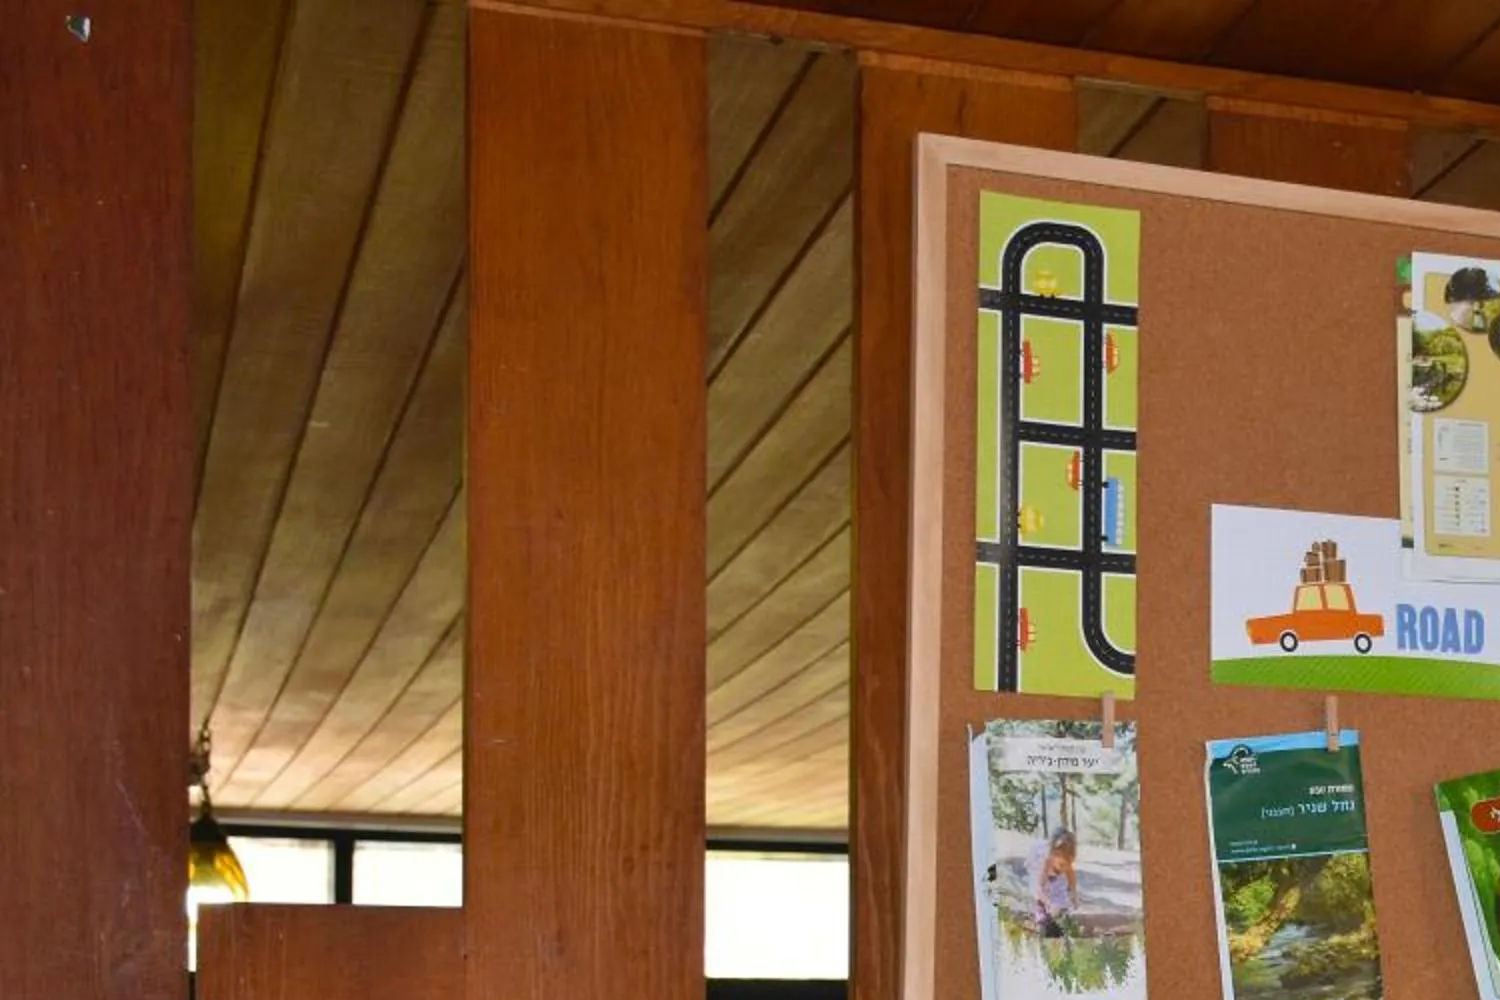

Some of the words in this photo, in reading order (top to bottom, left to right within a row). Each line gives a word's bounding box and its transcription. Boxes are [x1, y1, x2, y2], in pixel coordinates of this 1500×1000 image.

[1396, 604, 1485, 655] ROAD
[1297, 802, 1328, 816] שניר
[1332, 800, 1356, 813] נחל
